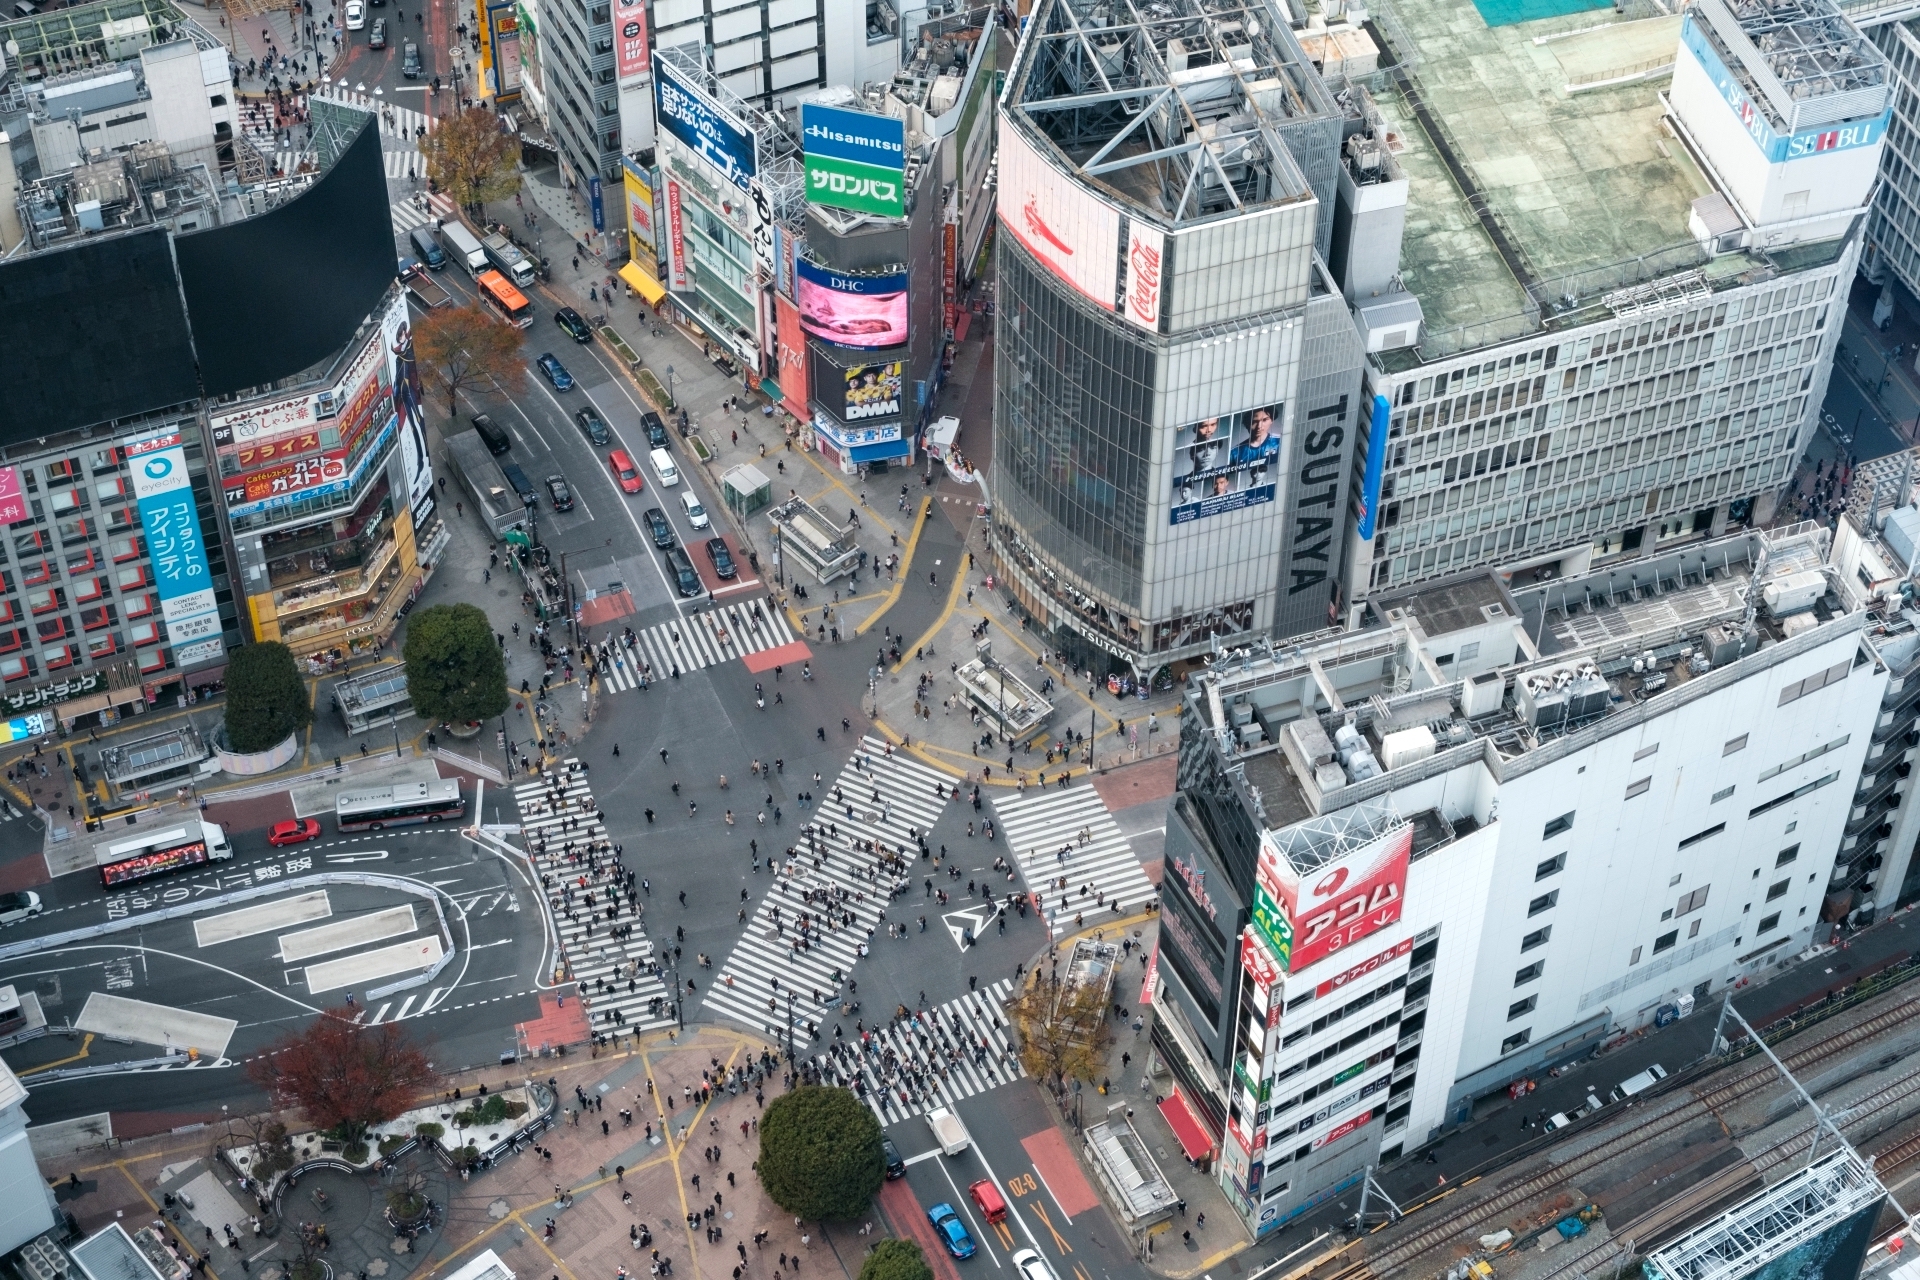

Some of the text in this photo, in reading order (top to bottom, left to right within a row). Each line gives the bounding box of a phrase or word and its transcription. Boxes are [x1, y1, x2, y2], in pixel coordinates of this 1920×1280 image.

[661, 81, 719, 126] 日本サッカーに
[662, 95, 726, 146] 足りないのは、
[805, 124, 902, 153] Hisamitsu
[1788, 123, 1872, 157] SEIBU
[811, 168, 898, 203] サロンパス
[830, 276, 864, 293] DHC
[846, 399, 900, 420] DMM
[214, 428, 231, 440] 9F
[239, 435, 318, 463] プライス
[294, 456, 331, 474] ガスト
[141, 476, 183, 492] eyecity
[226, 488, 245, 502] 7F
[248, 484, 269, 493] Café
[272, 472, 318, 494] ガスト
[1288, 394, 1349, 597] TSUTAYA
[147, 507, 181, 581] アイシティ
[173, 502, 202, 577] コンタクトの
[169, 602, 211, 617] SPECIALISTS
[173, 594, 203, 606] CONTACT
[180, 601, 198, 609] LENS
[1181, 607, 1253, 632] TSUTAYA
[1080, 626, 1135, 665] TSUTAYA
[8, 676, 97, 709] サンドラッグ
[1257, 889, 1293, 940] レイク
[1303, 882, 1400, 946] アコム
[1254, 908, 1290, 959] ALSA
[1327, 922, 1364, 953] 3F
[1340, 951, 1394, 979] アイフル
[1332, 1092, 1358, 1109] EAST
[1331, 1122, 1354, 1139] アコム
[1008, 1172, 1038, 1198] 8-20
